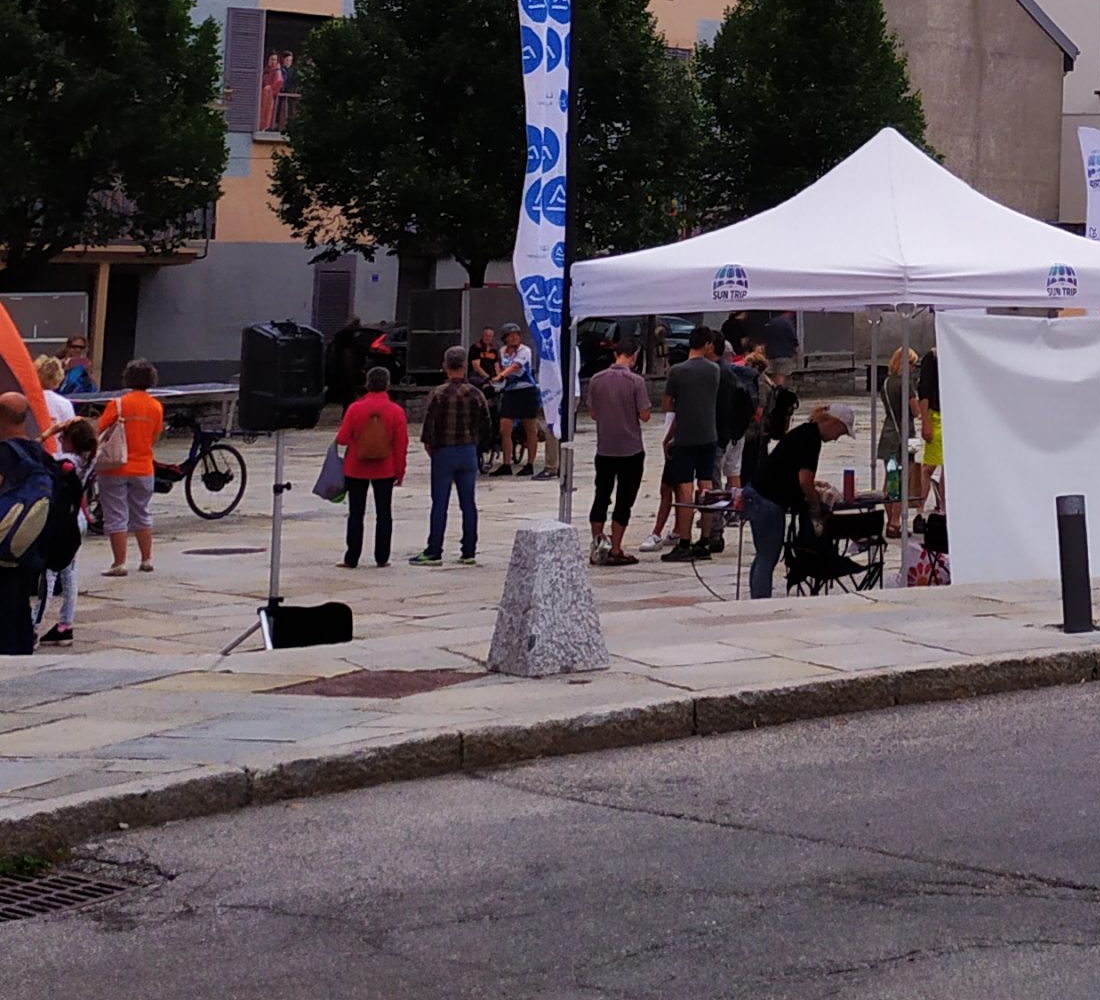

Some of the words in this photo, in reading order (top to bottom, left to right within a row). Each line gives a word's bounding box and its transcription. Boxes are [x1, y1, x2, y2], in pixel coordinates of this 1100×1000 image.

[713, 290, 729, 300] SUN
[730, 290, 748, 300] TRIP
[1047, 287, 1061, 297] SUN
[1062, 287, 1077, 297] TRIP
